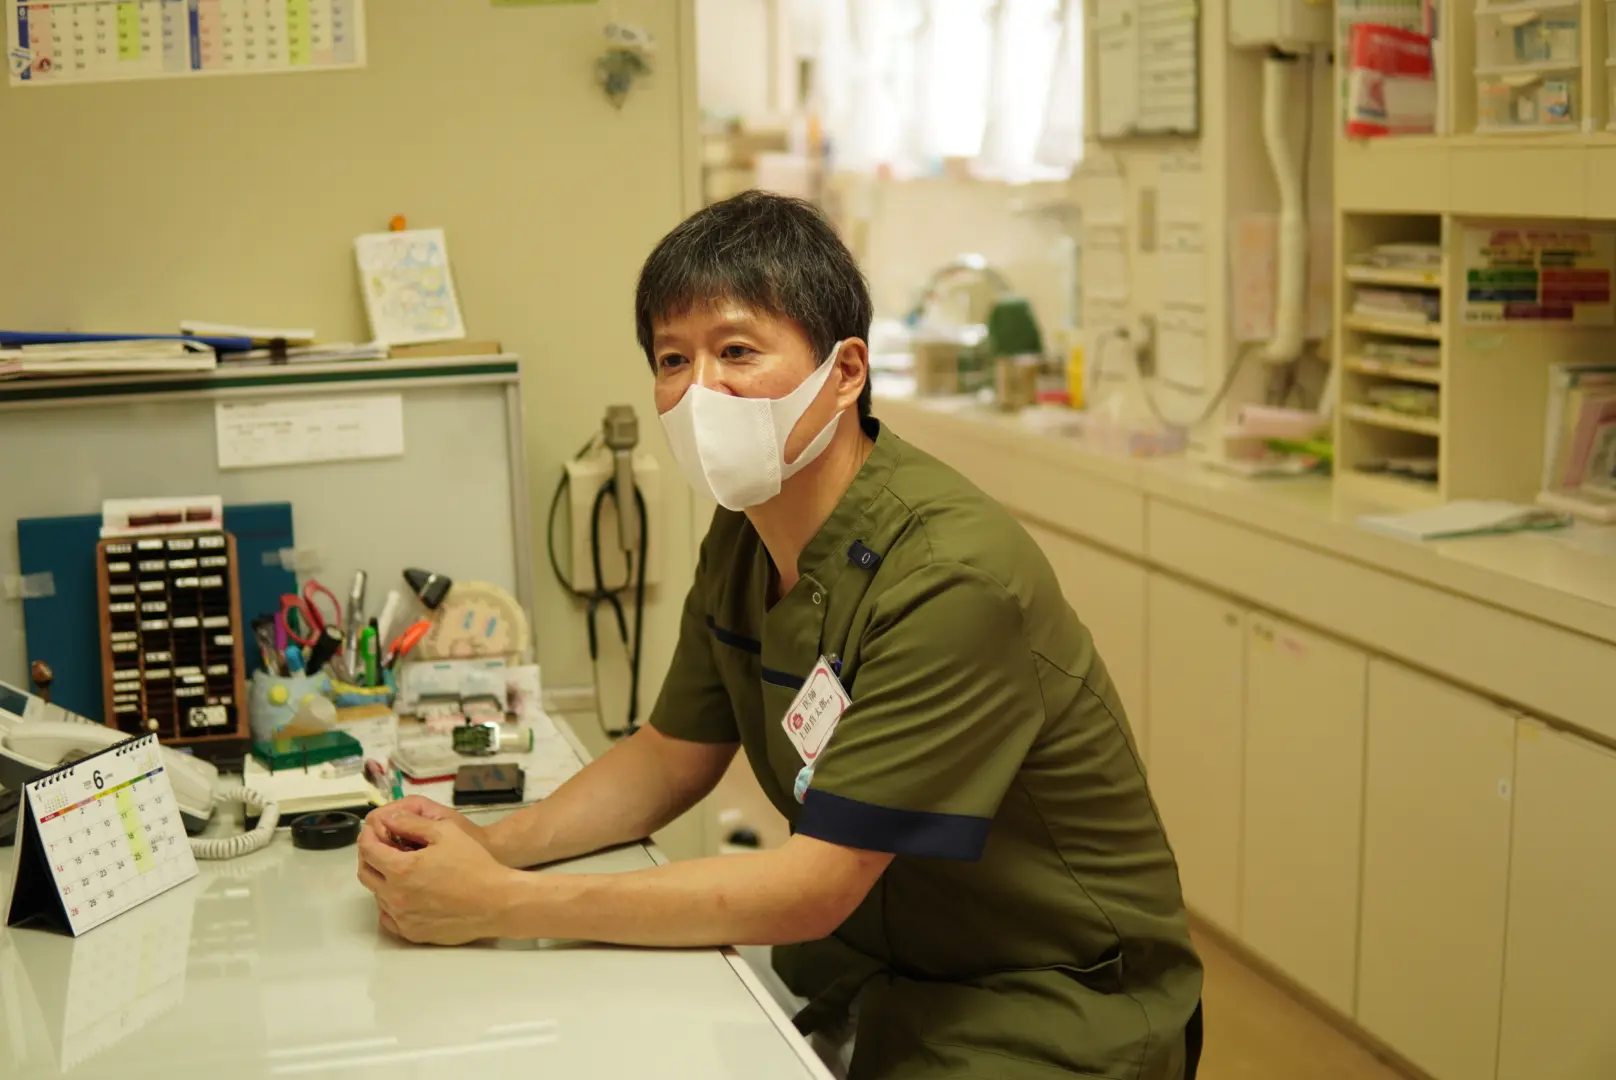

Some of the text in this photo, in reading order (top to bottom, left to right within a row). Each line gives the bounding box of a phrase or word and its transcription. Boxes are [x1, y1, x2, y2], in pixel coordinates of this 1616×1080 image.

[93, 769, 104, 790] 6
[80, 806, 85, 815] 2
[115, 791, 120, 799] 4
[132, 784, 137, 792] 5
[68, 836, 73, 844] 8
[86, 828, 91, 836] 9
[104, 819, 111, 827] 10
[121, 811, 128, 819] 11
[138, 804, 146, 812] 12
[155, 796, 162, 804] 13
[57, 816, 169, 873] 14 15 16 17 18 19 20
[63, 887, 71, 895] 21
[82, 878, 89, 886] 22
[100, 869, 107, 878] 23
[117, 860, 125, 869] 24
[134, 852, 142, 861] 25
[168, 835, 175, 845] 27
[71, 890, 114, 917] 28 29 30
